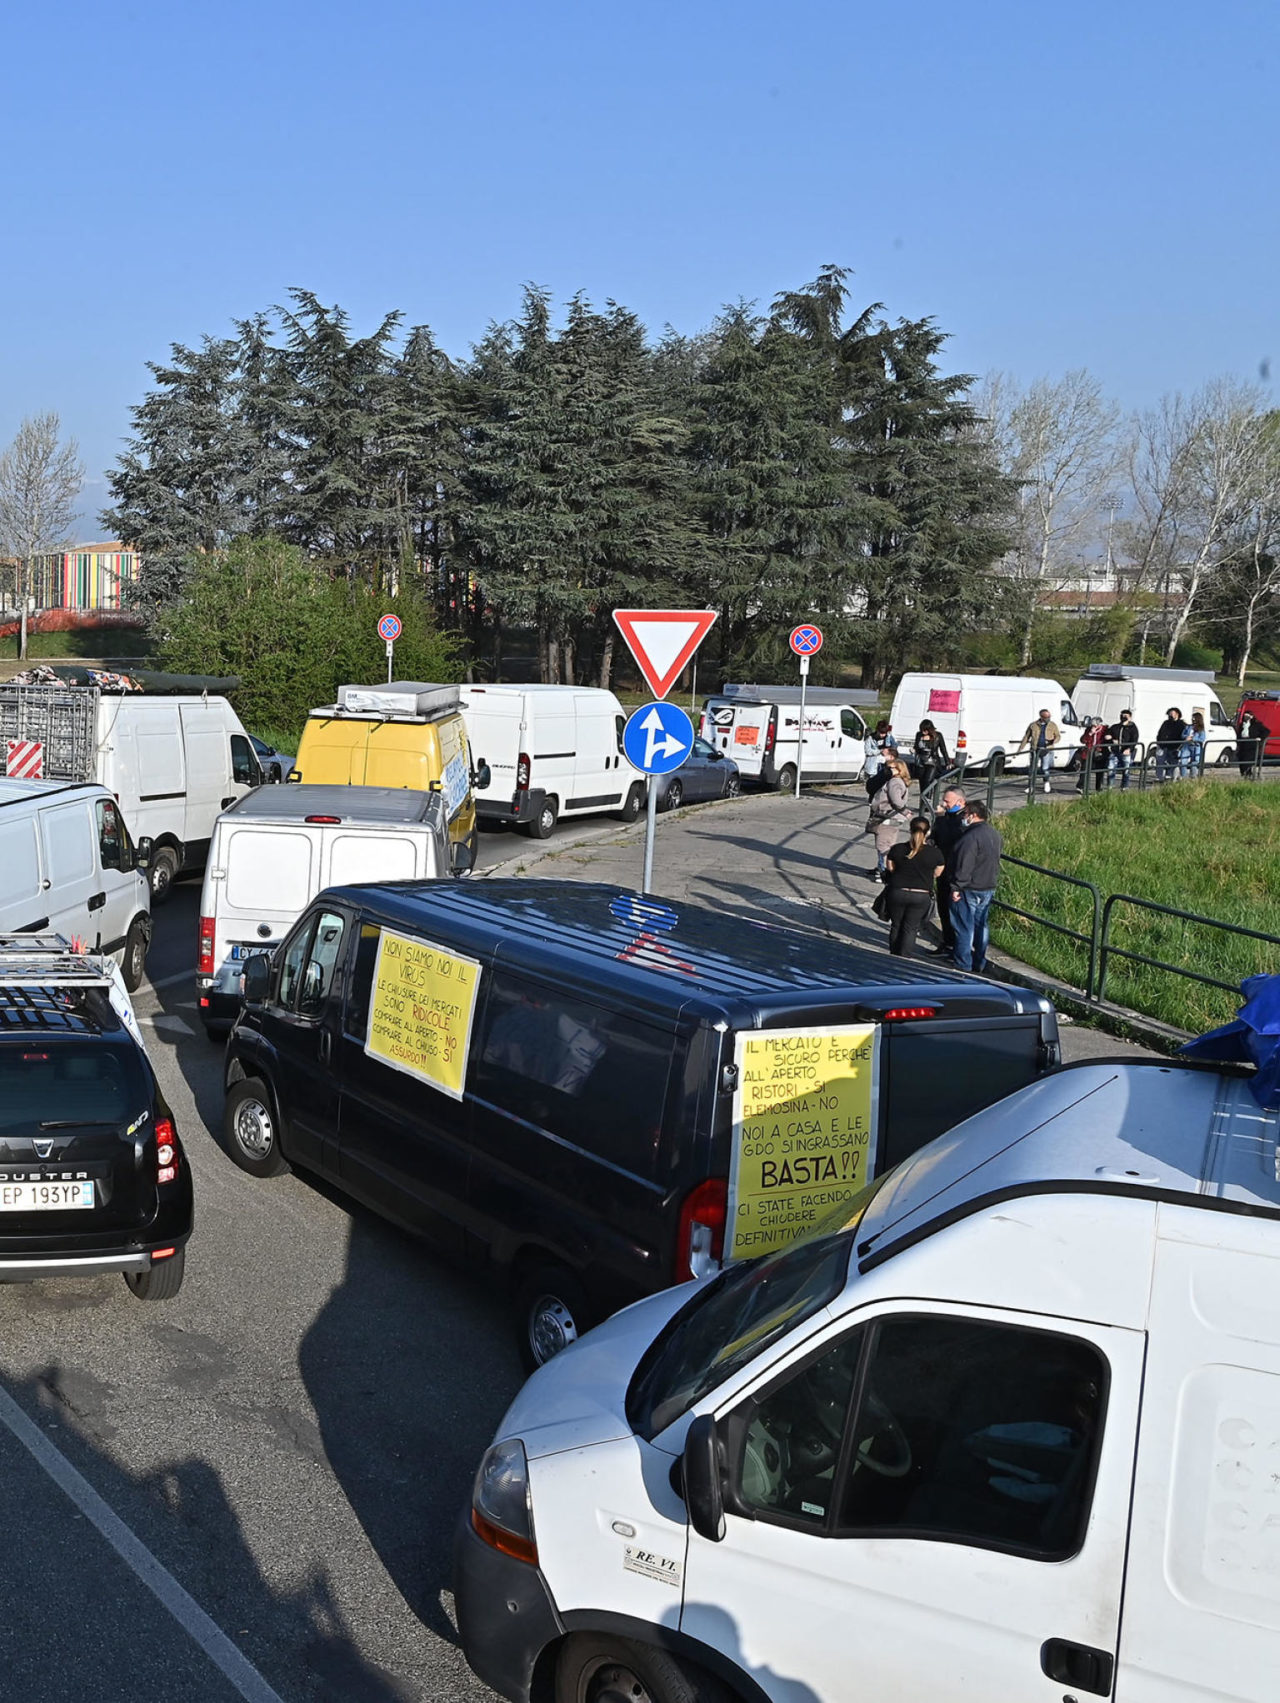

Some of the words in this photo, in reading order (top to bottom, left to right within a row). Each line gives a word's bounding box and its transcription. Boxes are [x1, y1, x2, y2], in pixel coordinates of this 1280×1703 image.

[384, 940, 402, 957] NON
[405, 946, 434, 968] SIAMO
[436, 958, 454, 976] NOI
[457, 965, 467, 981] IL
[400, 963, 426, 987] VIRUS
[377, 978, 386, 991] LE
[431, 998, 462, 1020] MERCATI
[383, 995, 405, 1013] SONO
[412, 1003, 451, 1032] RIDICOLE
[405, 1035, 413, 1048] AL
[415, 1038, 438, 1057] CHIUSO
[442, 1048, 453, 1063] SI
[445, 1034, 458, 1050] NO
[746, 1040, 759, 1054] IL
[765, 1036, 823, 1052] MERCATO
[773, 1051, 821, 1067] SICURO
[752, 1083, 798, 1100] RISTORI
[813, 1080, 826, 1094] SI
[744, 1100, 810, 1118] ELEMOSINA
[819, 1096, 839, 1111] NO
[742, 1125, 765, 1141] NOI
[770, 1124, 781, 1139] A
[787, 1120, 822, 1137] CASA
[831, 1118, 839, 1133] E
[847, 1116, 863, 1131] LE
[743, 1142, 775, 1157] GDO
[3, 1186, 23, 1205] EP
[32, 1183, 81, 1204] 193YP
[737, 1203, 750, 1217] CI
[757, 1197, 795, 1215] STATE
[801, 1189, 853, 1208] FACENDO
[760, 1209, 817, 1227] CHIUDERE
[636, 1550, 656, 1565] RE.
[661, 1557, 676, 1572] VI.
